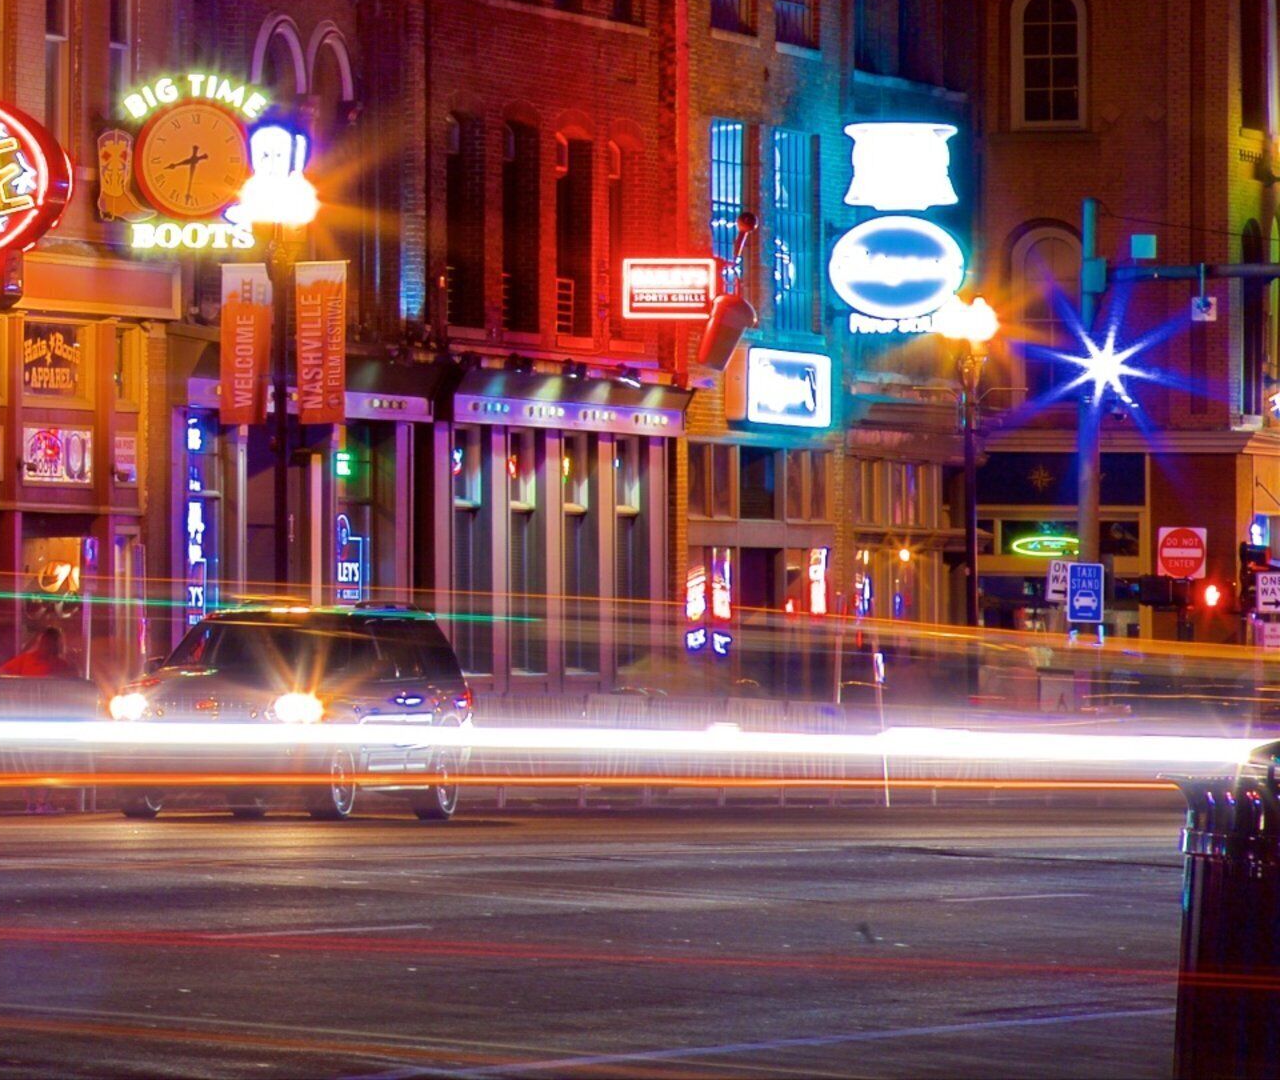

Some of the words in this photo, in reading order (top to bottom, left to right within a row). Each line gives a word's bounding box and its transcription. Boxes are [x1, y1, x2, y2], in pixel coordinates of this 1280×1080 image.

[124, 78, 179, 119] BIG
[187, 74, 268, 119] TIME
[131, 222, 256, 249] BOOTS
[633, 293, 669, 303] SPORTS
[670, 293, 706, 303] GRILLE
[327, 296, 342, 351] FESTIVAL
[24, 337, 48, 363] Hats
[301, 294, 324, 409] NASHVILLE
[233, 315, 255, 408] WELCOME
[30, 366, 74, 390] APPAREL
[1166, 537, 1178, 547] DO
[1182, 537, 1199, 547] NOT
[1053, 562, 1068, 573] ON
[1076, 566, 1097, 578] TAXI
[1167, 559, 1195, 568] ENTER
[1051, 575, 1067, 585] WA
[1071, 578, 1100, 590] STAND
